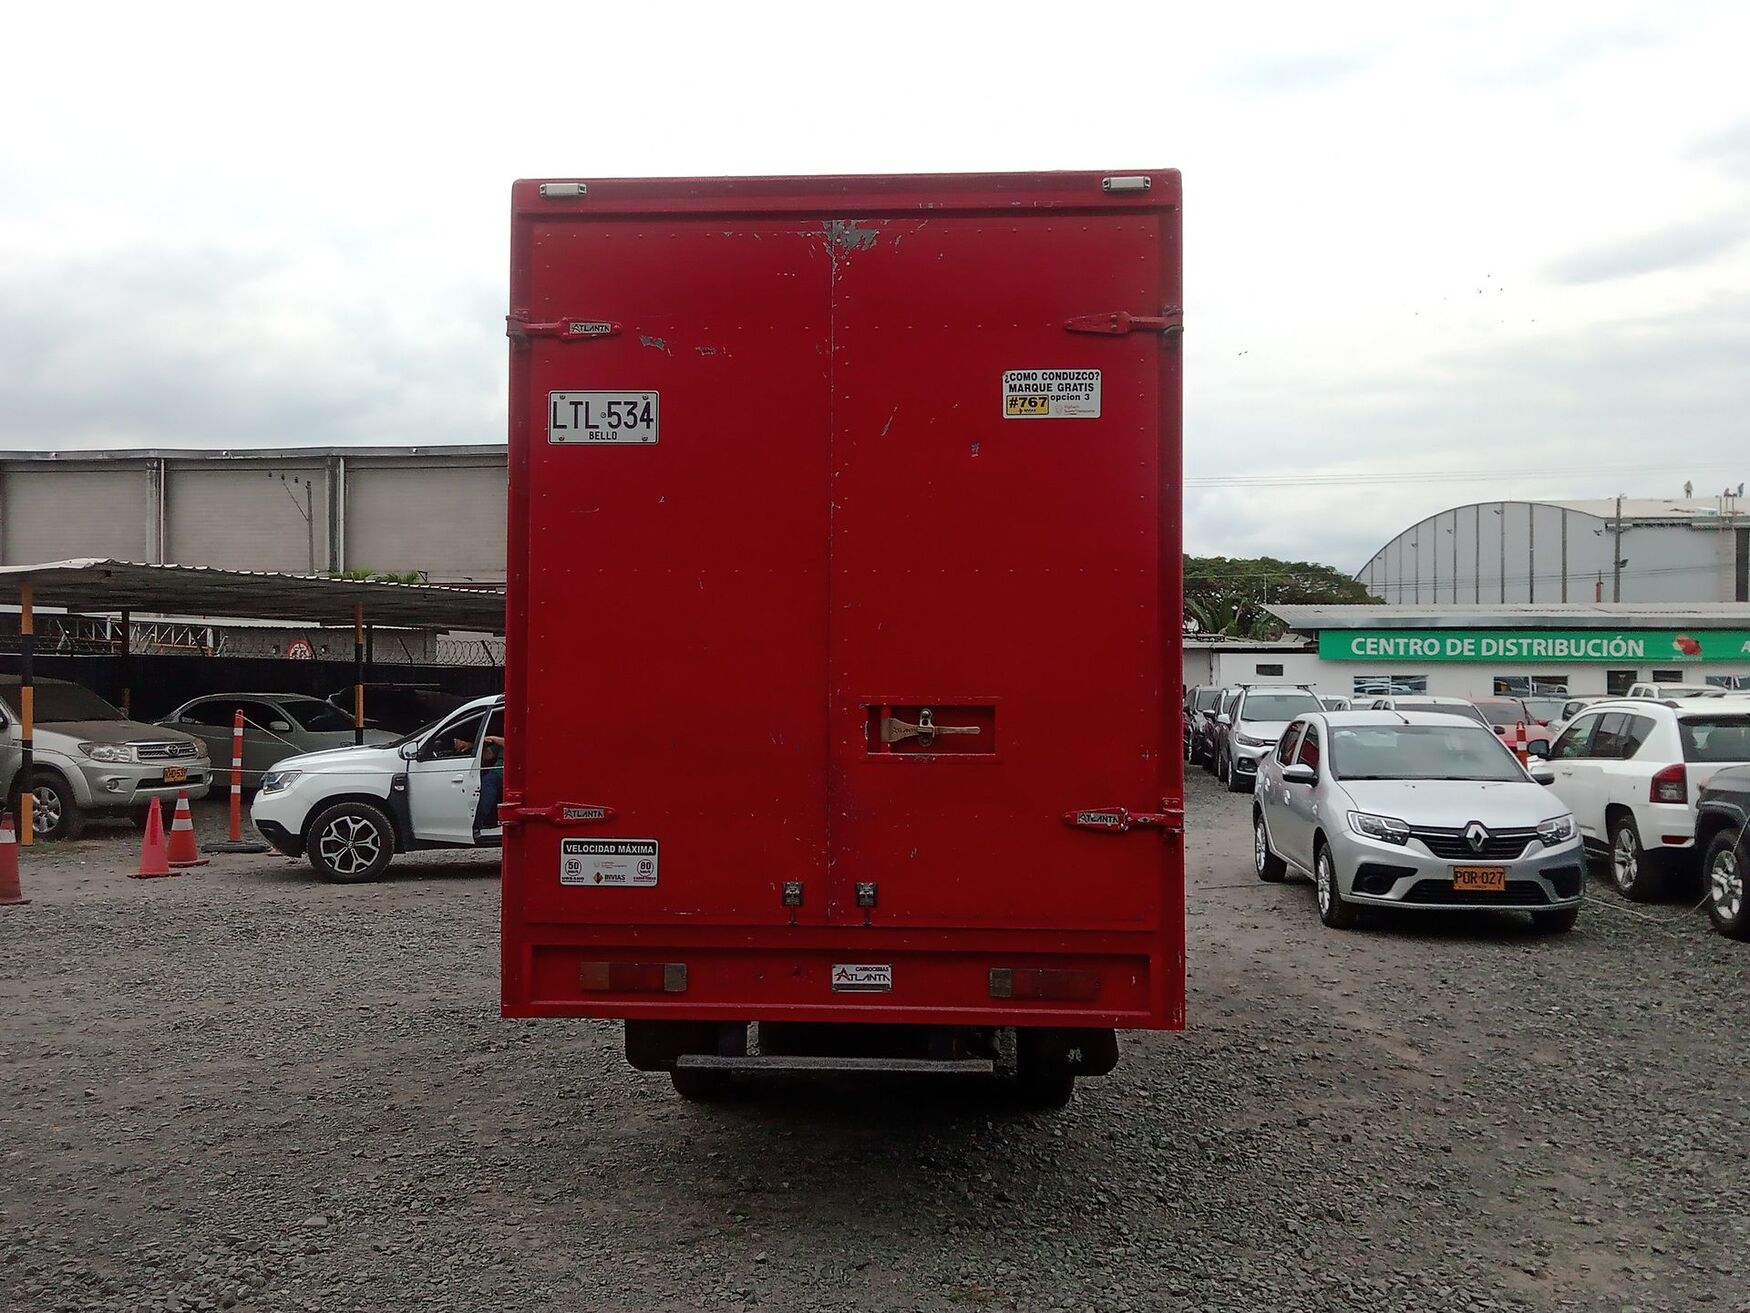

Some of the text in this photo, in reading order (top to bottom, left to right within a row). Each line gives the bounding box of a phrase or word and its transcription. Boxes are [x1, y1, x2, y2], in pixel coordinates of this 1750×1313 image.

[571, 324, 610, 332] ATLANTA
[1004, 371, 1100, 383] ¿COMO CONDUZCO?
[1008, 383, 1094, 393] MARQUE GRATIS
[1008, 396, 1048, 408] #767
[1050, 392, 1081, 402] opcion
[552, 401, 654, 429] LTL 534
[589, 431, 618, 440] BELLO
[1351, 635, 1644, 657] CENTRO DE DISTRIBUCIÓN
[564, 809, 604, 819] ATLANTA
[566, 843, 654, 854] VELOCIDAD MÁXIMA
[568, 861, 579, 870] 50
[640, 861, 651, 870] 80
[1481, 871, 1504, 885] 027
[834, 967, 891, 982] ATLANTA
